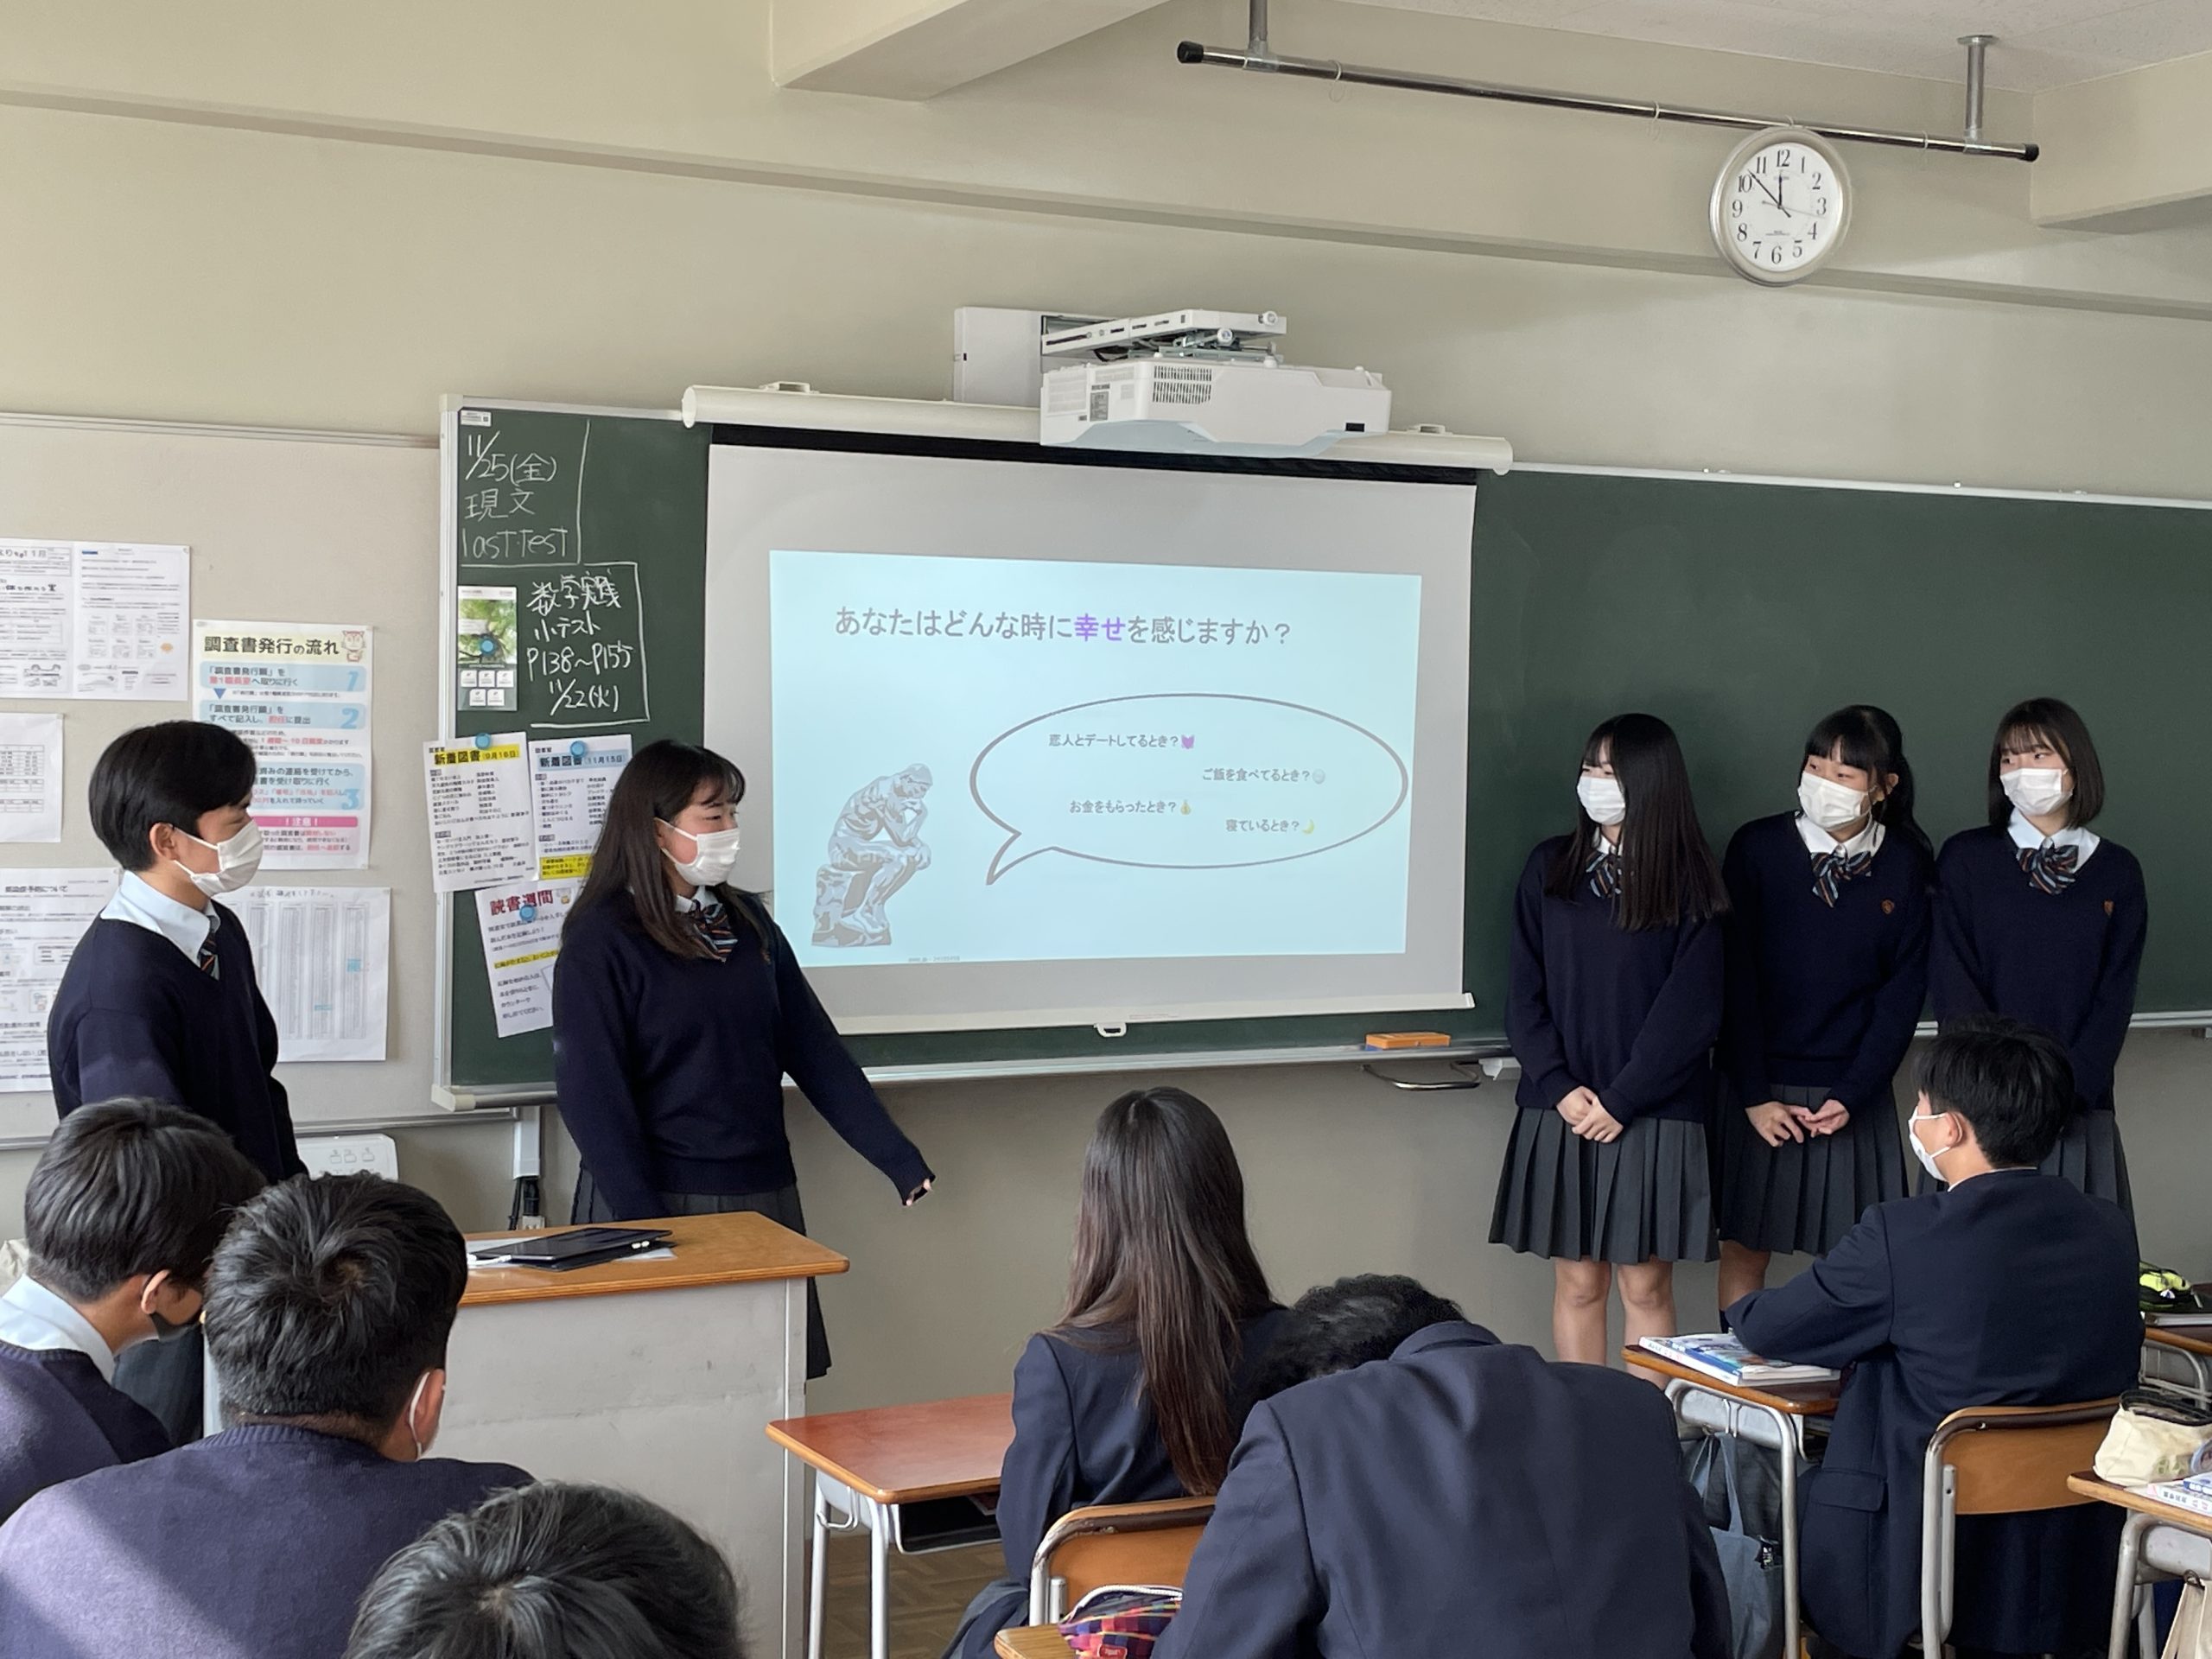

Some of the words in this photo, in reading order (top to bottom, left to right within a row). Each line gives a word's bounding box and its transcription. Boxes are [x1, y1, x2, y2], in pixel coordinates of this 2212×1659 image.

[1756, 156, 1766, 174] 11
[1777, 149, 1790, 168] 12
[1800, 156, 1805, 174] 1
[1738, 174, 1752, 193] 10
[1812, 172, 1821, 190] 2
[1732, 200, 1743, 218] 9
[1816, 197, 1827, 215] 3
[1737, 222, 1747, 242] 8
[1808, 222, 1817, 240] 4
[1752, 241, 1762, 259] 7
[1771, 245, 1782, 264] 6
[1793, 240, 1802, 258] 5
[464, 487, 536, 523] 現文
[534, 610, 601, 643] 小テスト
[836, 606, 1291, 645] あなたはどんな時に幸せを感じますか？
[204, 636, 340, 655] 調査書発行の流れ
[340, 708, 359, 729] 2
[340, 788, 360, 810] 3
[1069, 800, 1177, 815] お金をもらったとき？
[1225, 819, 1300, 832] 寝ているとき？
[490, 889, 554, 916] 読書週間
